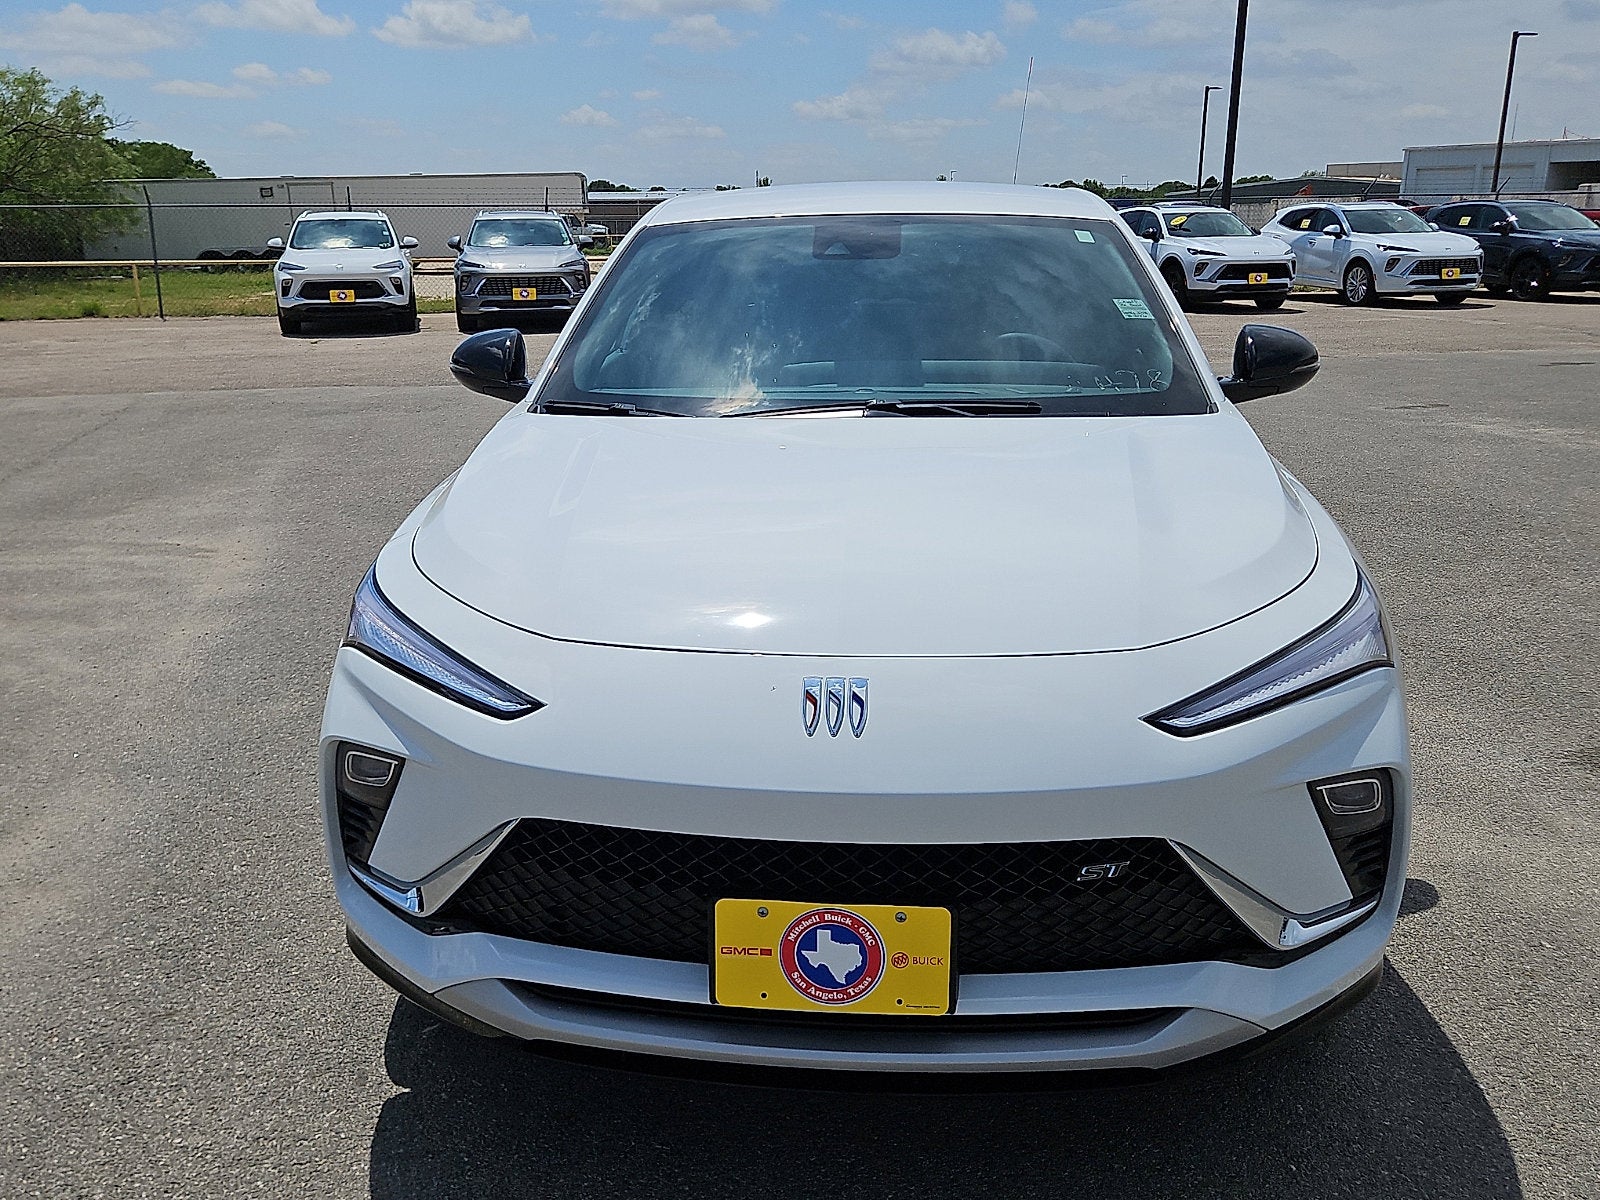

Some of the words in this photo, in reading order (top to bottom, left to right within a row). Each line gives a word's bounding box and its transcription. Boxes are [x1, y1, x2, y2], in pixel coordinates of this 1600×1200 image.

[1077, 860, 1130, 881] ST
[787, 914, 820, 942] Mitchell
[824, 913, 853, 926] Buick
[858, 926, 876, 947] GMC
[720, 946, 759, 956] GMC
[912, 956, 944, 966] BUICK
[791, 971, 807, 989] San
[807, 986, 847, 1000] Angelo,
[847, 976, 872, 996] Texas
